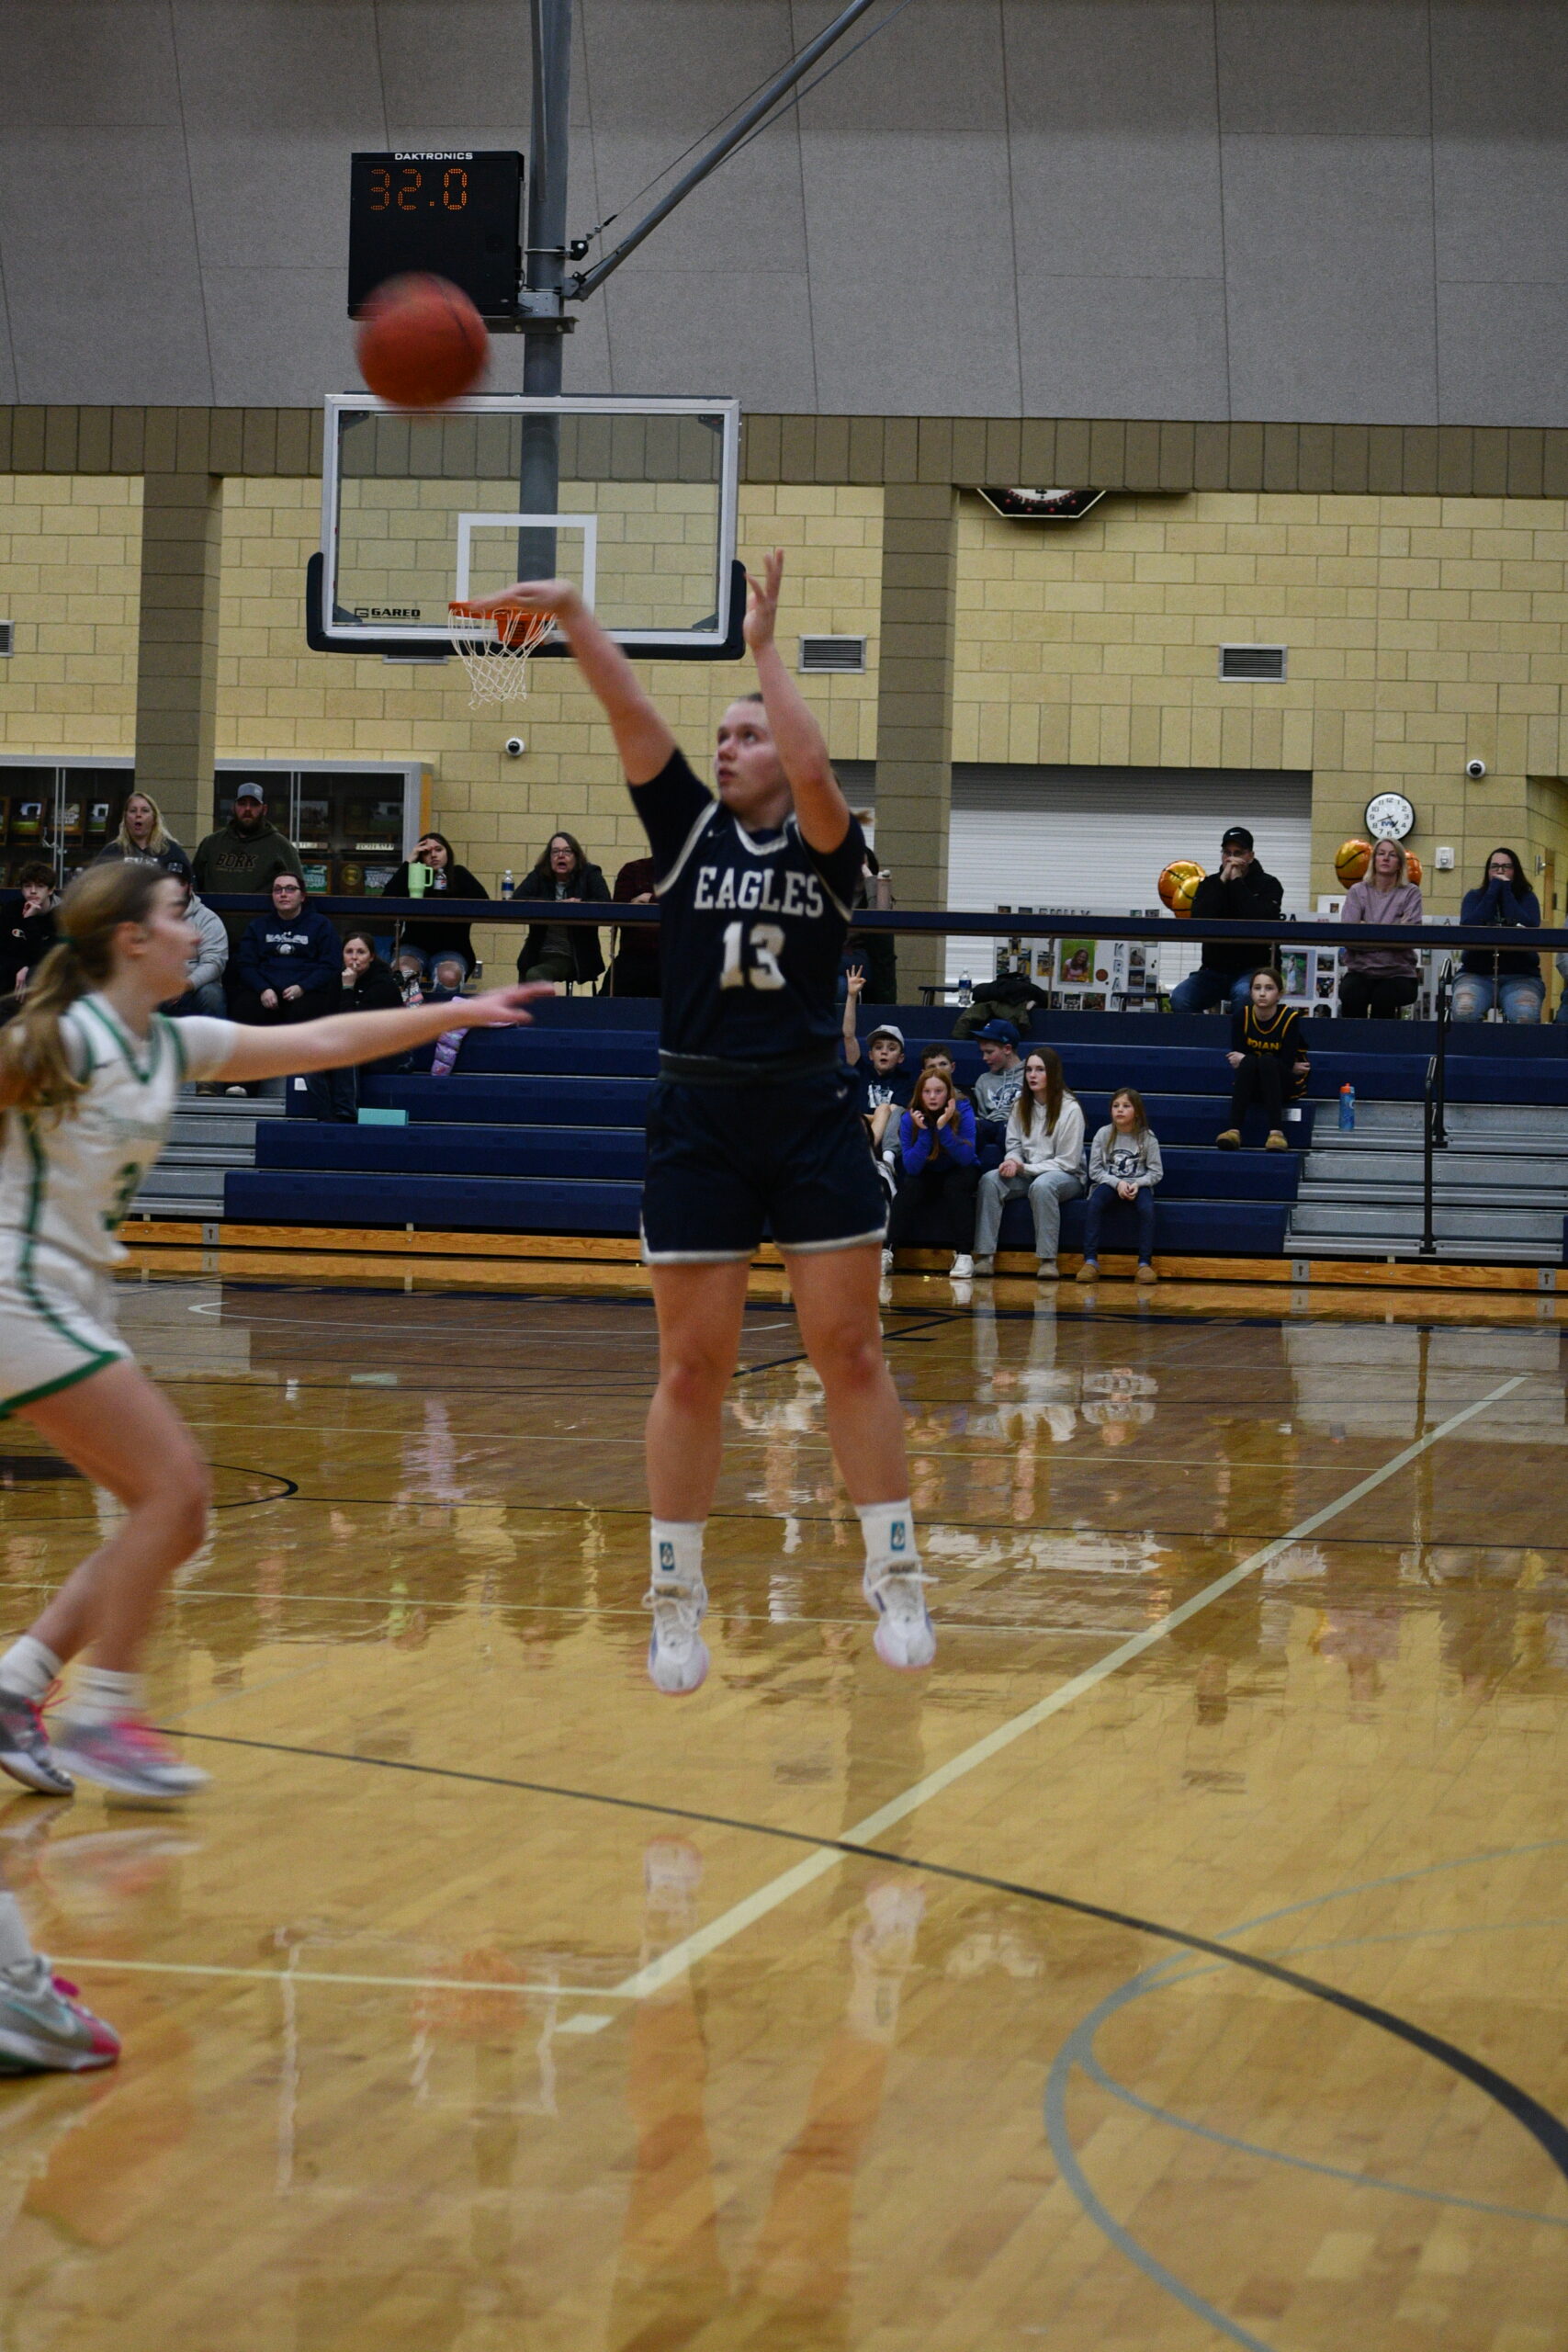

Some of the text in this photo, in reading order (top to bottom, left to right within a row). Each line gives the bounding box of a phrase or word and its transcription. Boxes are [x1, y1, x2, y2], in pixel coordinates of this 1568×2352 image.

[394, 152, 473, 161] DAKTRONICS
[370, 168, 468, 210] 32.0
[371, 607, 421, 617] GARED
[694, 865, 824, 918] EAGLES
[720, 921, 786, 991] 13
